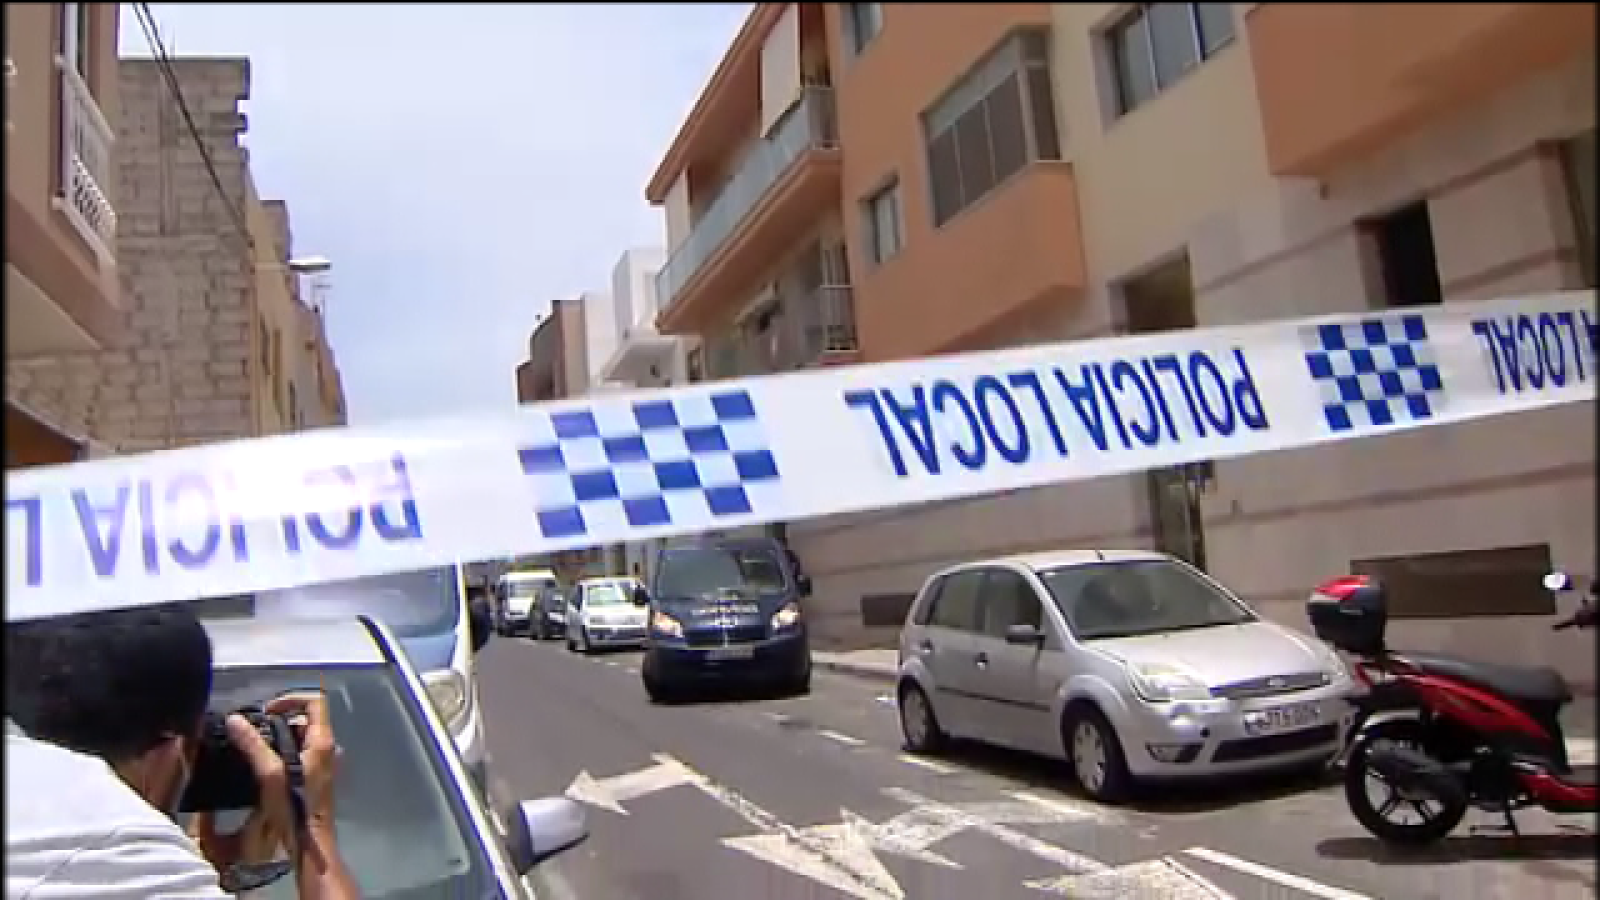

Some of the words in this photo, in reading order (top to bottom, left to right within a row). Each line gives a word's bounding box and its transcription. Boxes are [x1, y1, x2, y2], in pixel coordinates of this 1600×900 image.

[1054, 347, 1270, 451] POLICIA
[1470, 311, 1586, 395] LOCAL
[844, 369, 1068, 476] LOCAL
